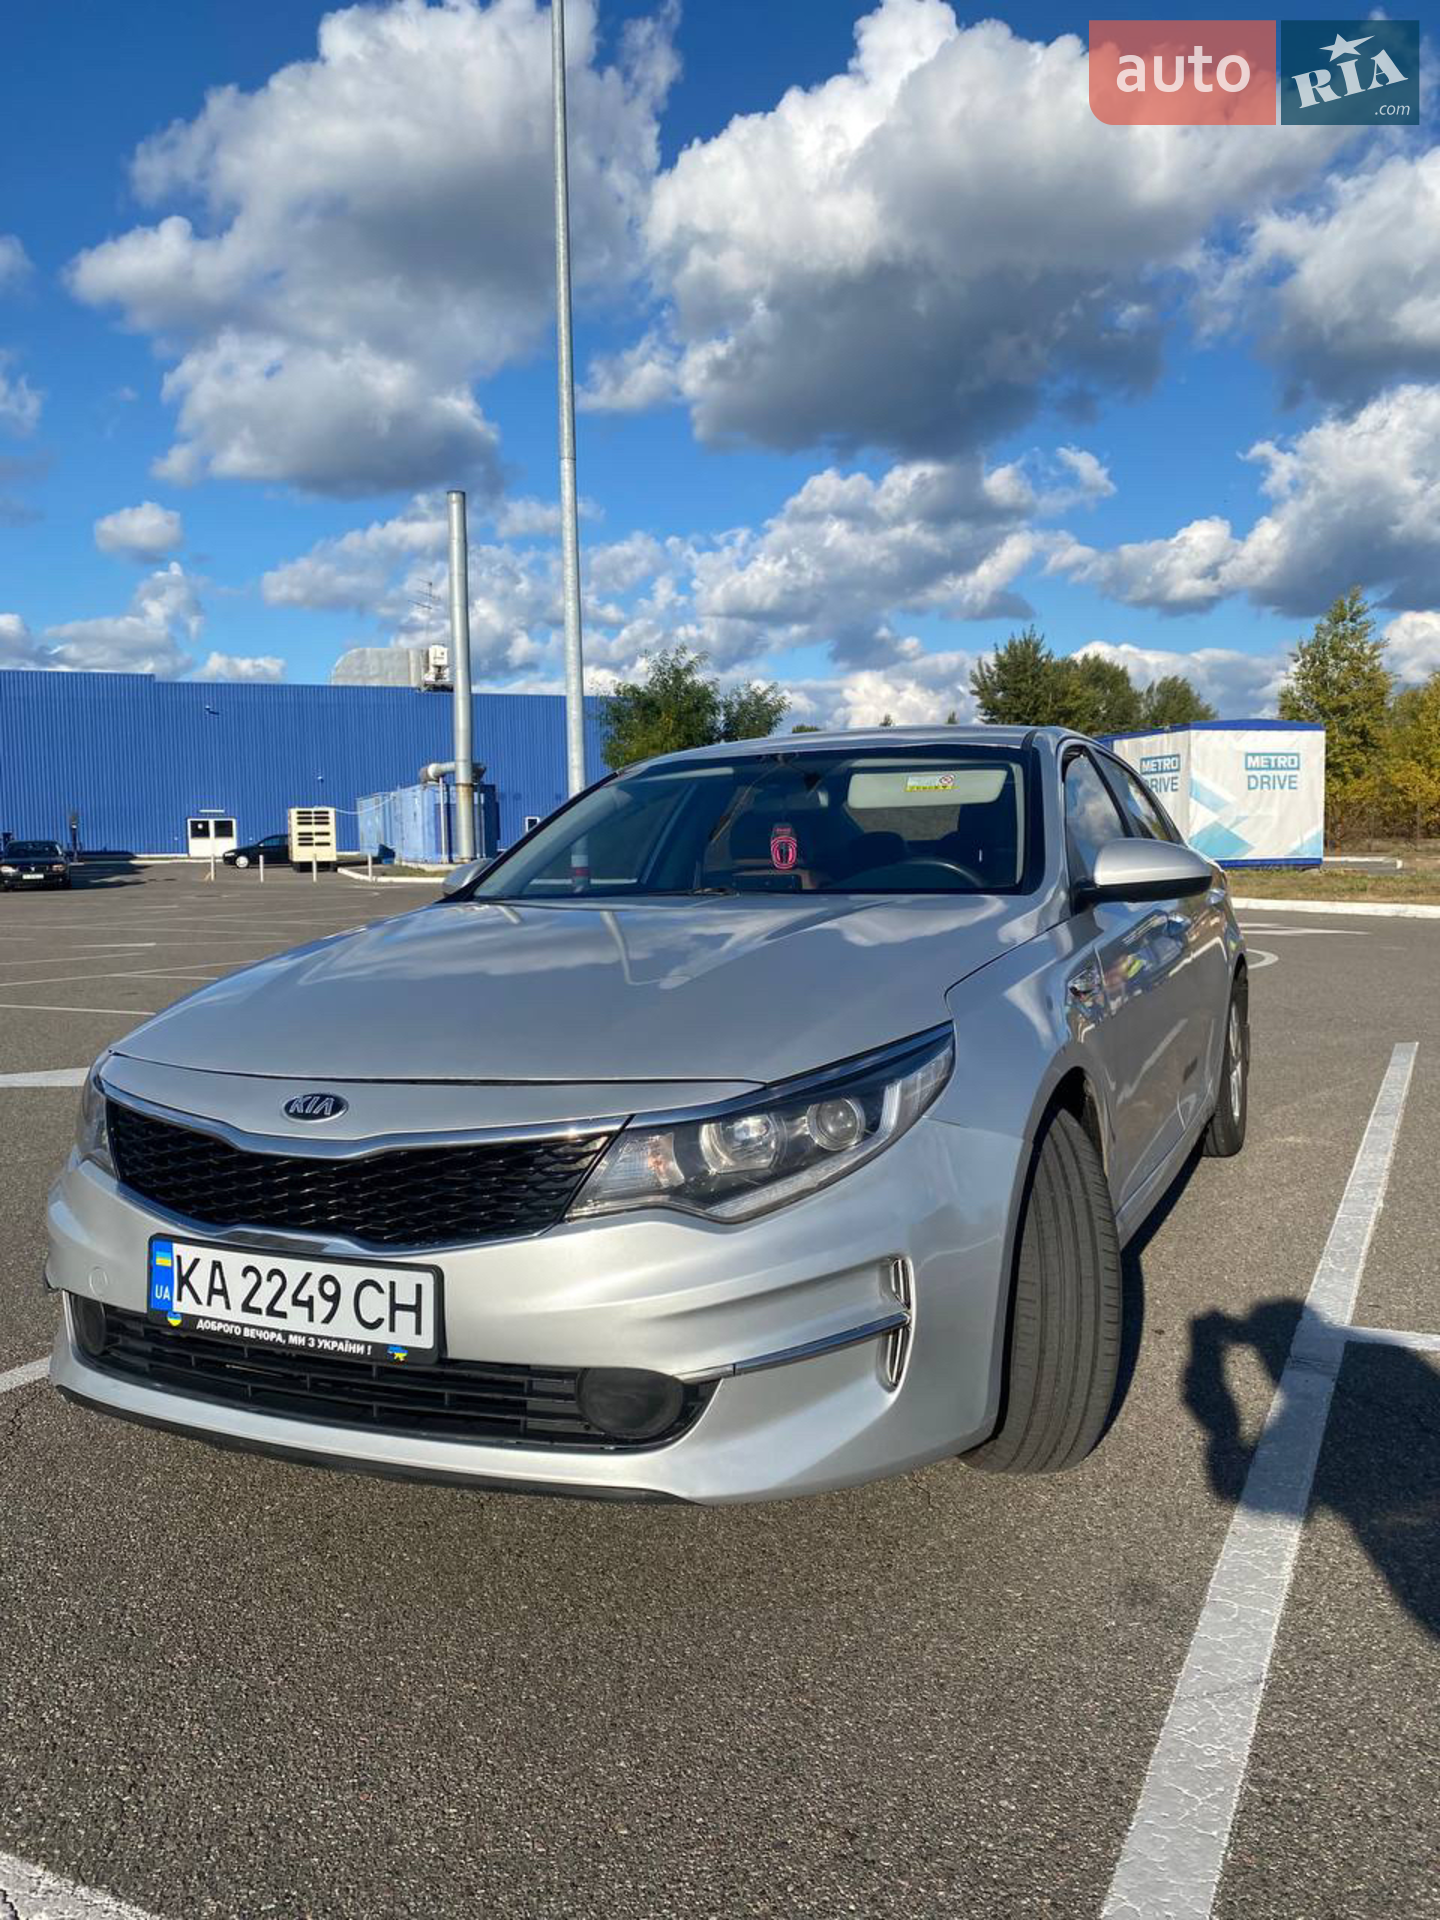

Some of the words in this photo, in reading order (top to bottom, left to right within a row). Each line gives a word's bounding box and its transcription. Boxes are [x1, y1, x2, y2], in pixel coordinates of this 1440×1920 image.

[1141, 756, 1179, 773] METRO
[1246, 754, 1299, 770] METRO
[1247, 774, 1298, 790] DRIVE
[288, 1095, 335, 1115] KIA
[155, 1284, 171, 1301] UA
[176, 1254, 231, 1310] KA
[241, 1265, 341, 1325] 2249
[353, 1278, 423, 1336] CH
[196, 1319, 242, 1336] ДОБРОГО
[243, 1325, 286, 1344] ВЕЧОРА,
[288, 1335, 306, 1346] МИ
[317, 1338, 366, 1355] УКРАЇНИ
